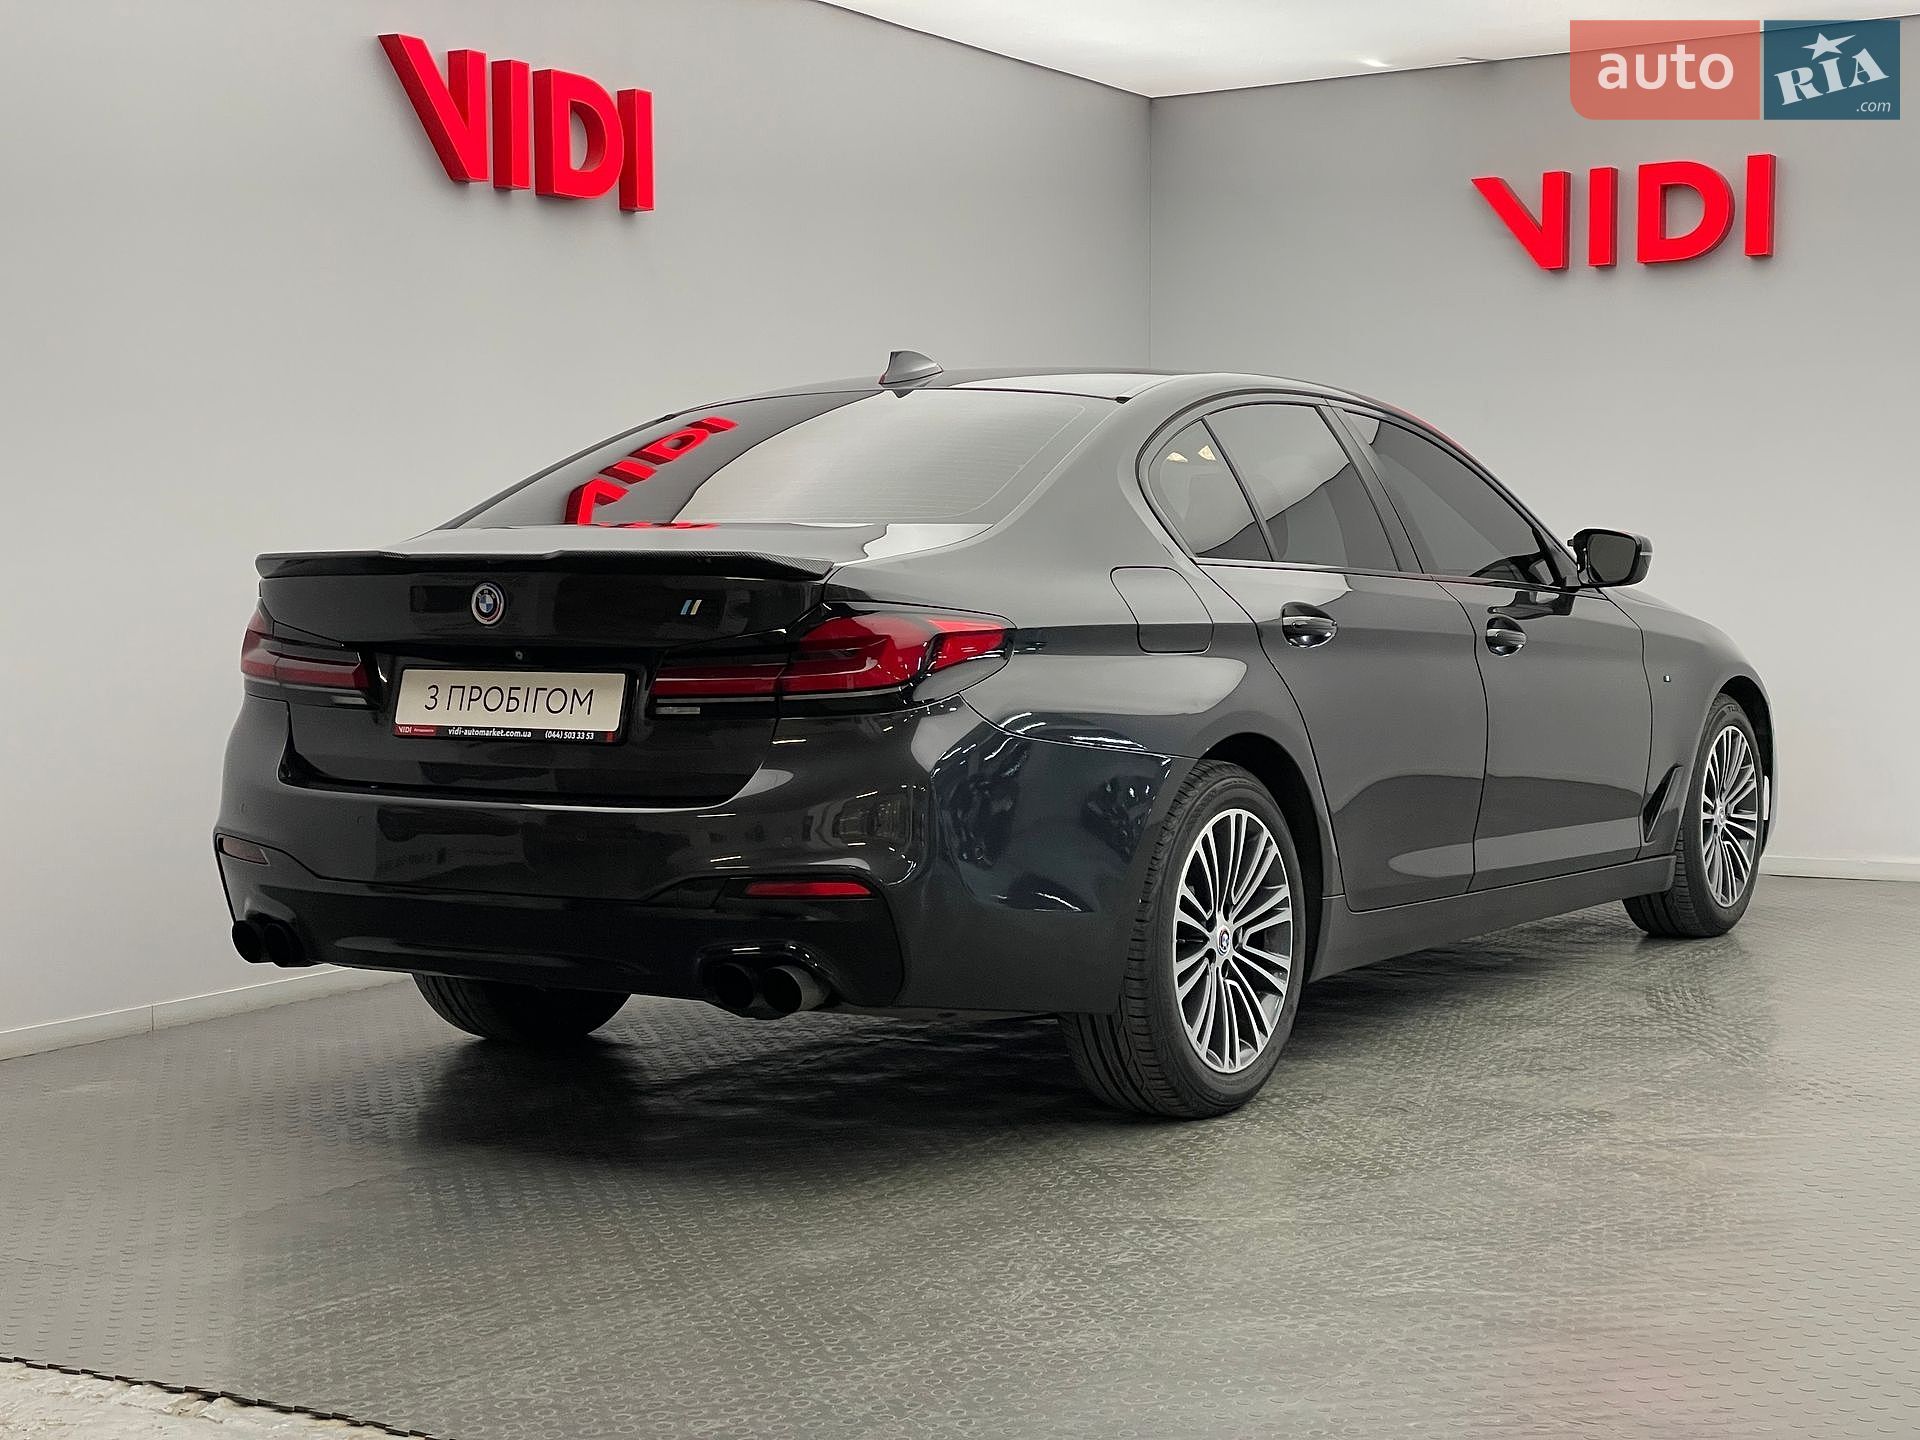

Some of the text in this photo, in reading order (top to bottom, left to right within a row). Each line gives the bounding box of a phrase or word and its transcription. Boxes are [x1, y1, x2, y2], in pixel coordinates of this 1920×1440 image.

[377, 32, 654, 212] VIDI
[1471, 153, 1777, 270] VIDI
[424, 684, 595, 715] З ПРОБІГОМ
[398, 725, 412, 734] VIDI
[448, 727, 532, 738] vidi-automarket.com.ua
[545, 731, 595, 740] (044) 503 33 53
